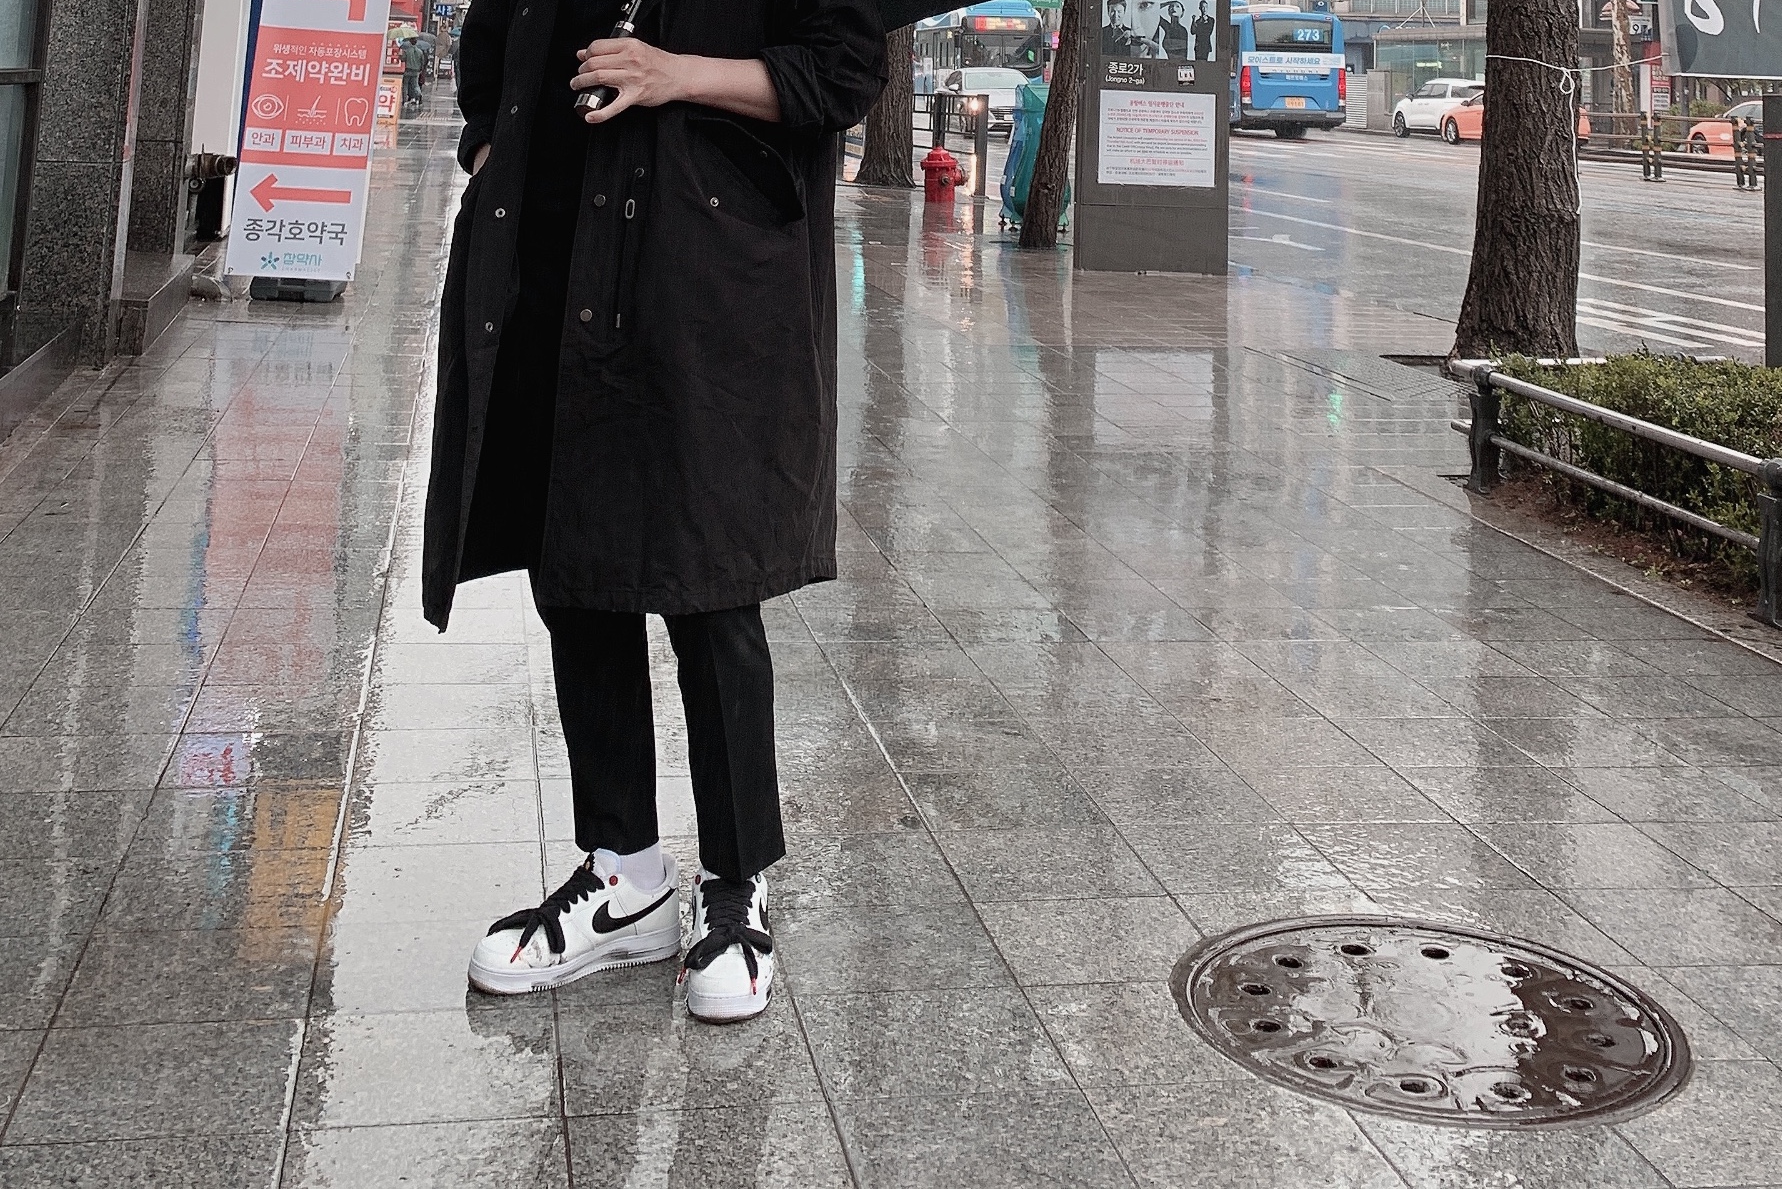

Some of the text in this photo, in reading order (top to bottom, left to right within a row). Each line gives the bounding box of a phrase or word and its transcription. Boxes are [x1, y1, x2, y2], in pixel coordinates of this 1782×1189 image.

[1297, 28, 1320, 41] 273
[273, 43, 368, 60] 위생적인 자동포장시스템
[1107, 61, 1144, 76] 종로2가
[1285, 56, 1321, 65] 시작하세요
[261, 58, 371, 88] 조제약완비
[1142, 128, 1170, 136] TEMPORARY
[251, 132, 364, 152] 안과 피부과 치과
[242, 217, 348, 247] 종각호약국
